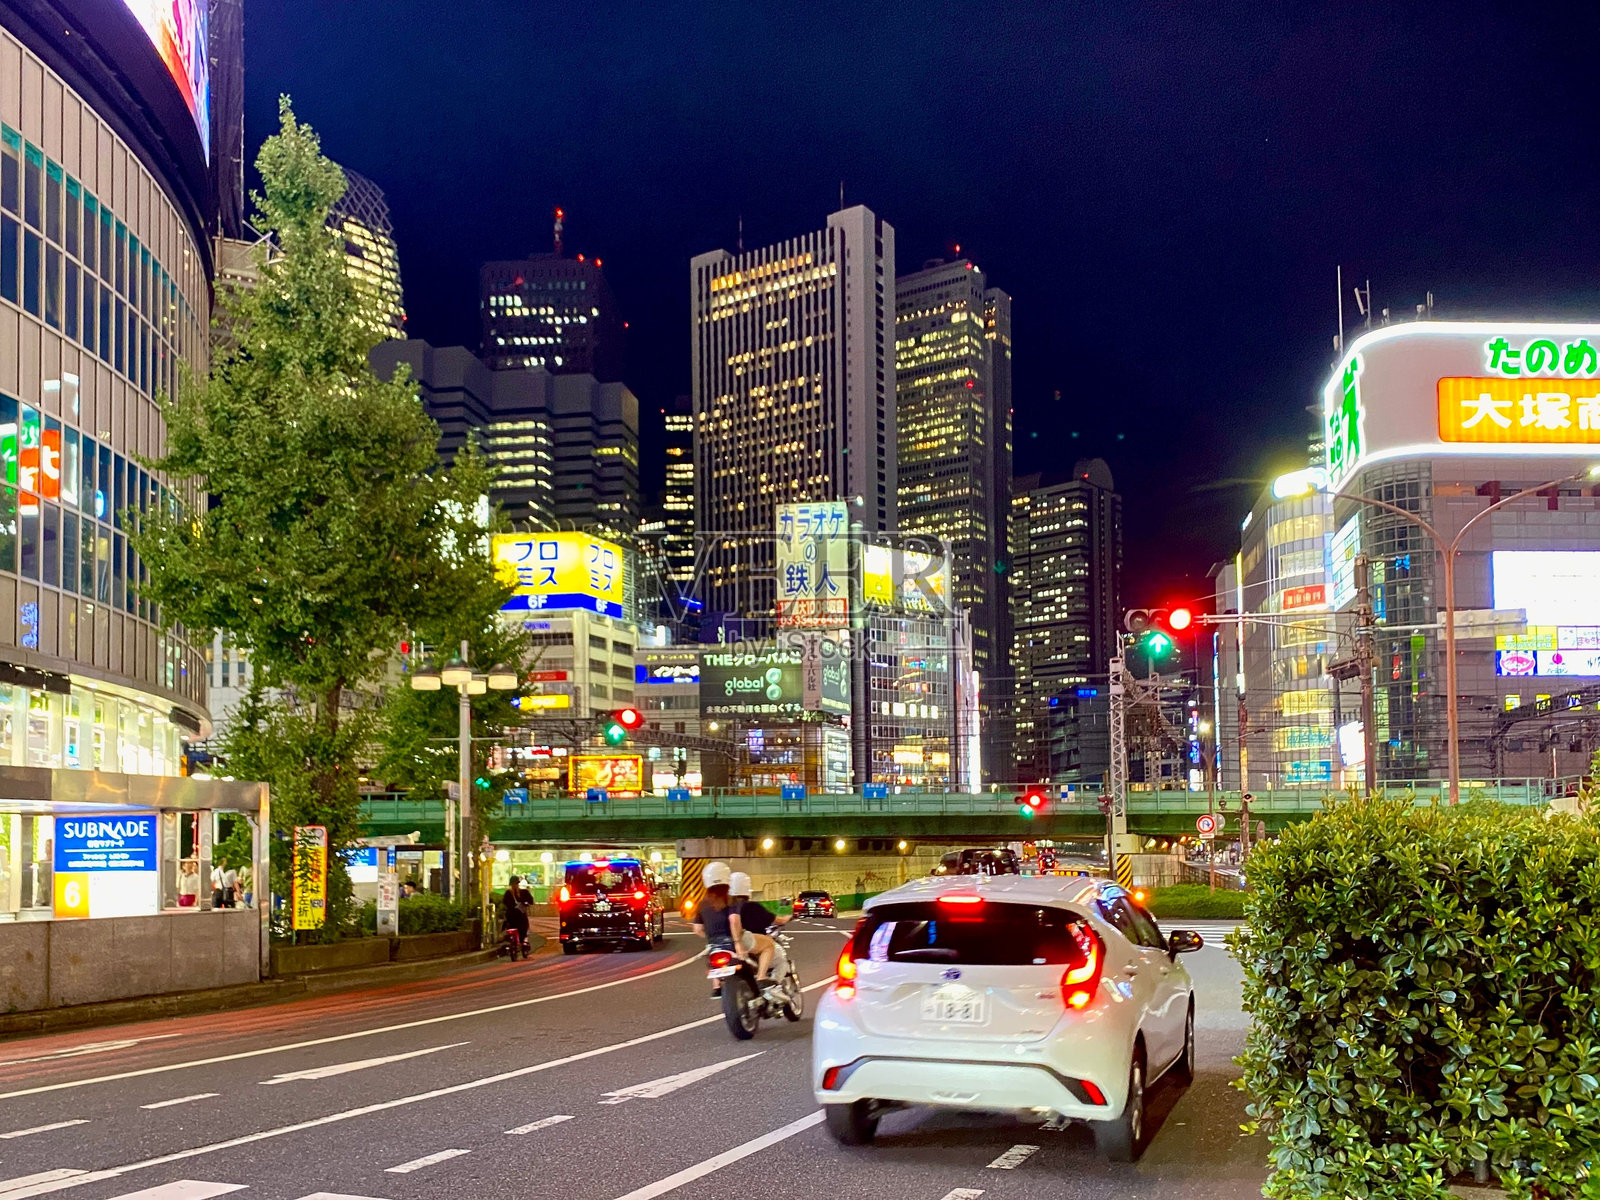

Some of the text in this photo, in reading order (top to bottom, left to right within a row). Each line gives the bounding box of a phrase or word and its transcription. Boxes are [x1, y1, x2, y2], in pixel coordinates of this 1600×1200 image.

[780, 508, 844, 541] カラオケ
[515, 541, 558, 561] プロ
[590, 544, 614, 569] プロ
[805, 542, 818, 563] の
[517, 566, 558, 586] ミス
[590, 569, 613, 593] ミス
[785, 563, 839, 595] 鉄人
[527, 594, 548, 609] 6F
[595, 600, 609, 613] 6F
[724, 676, 764, 696] global
[63, 820, 149, 840] SUBNADE
[64, 881, 81, 908] 6
